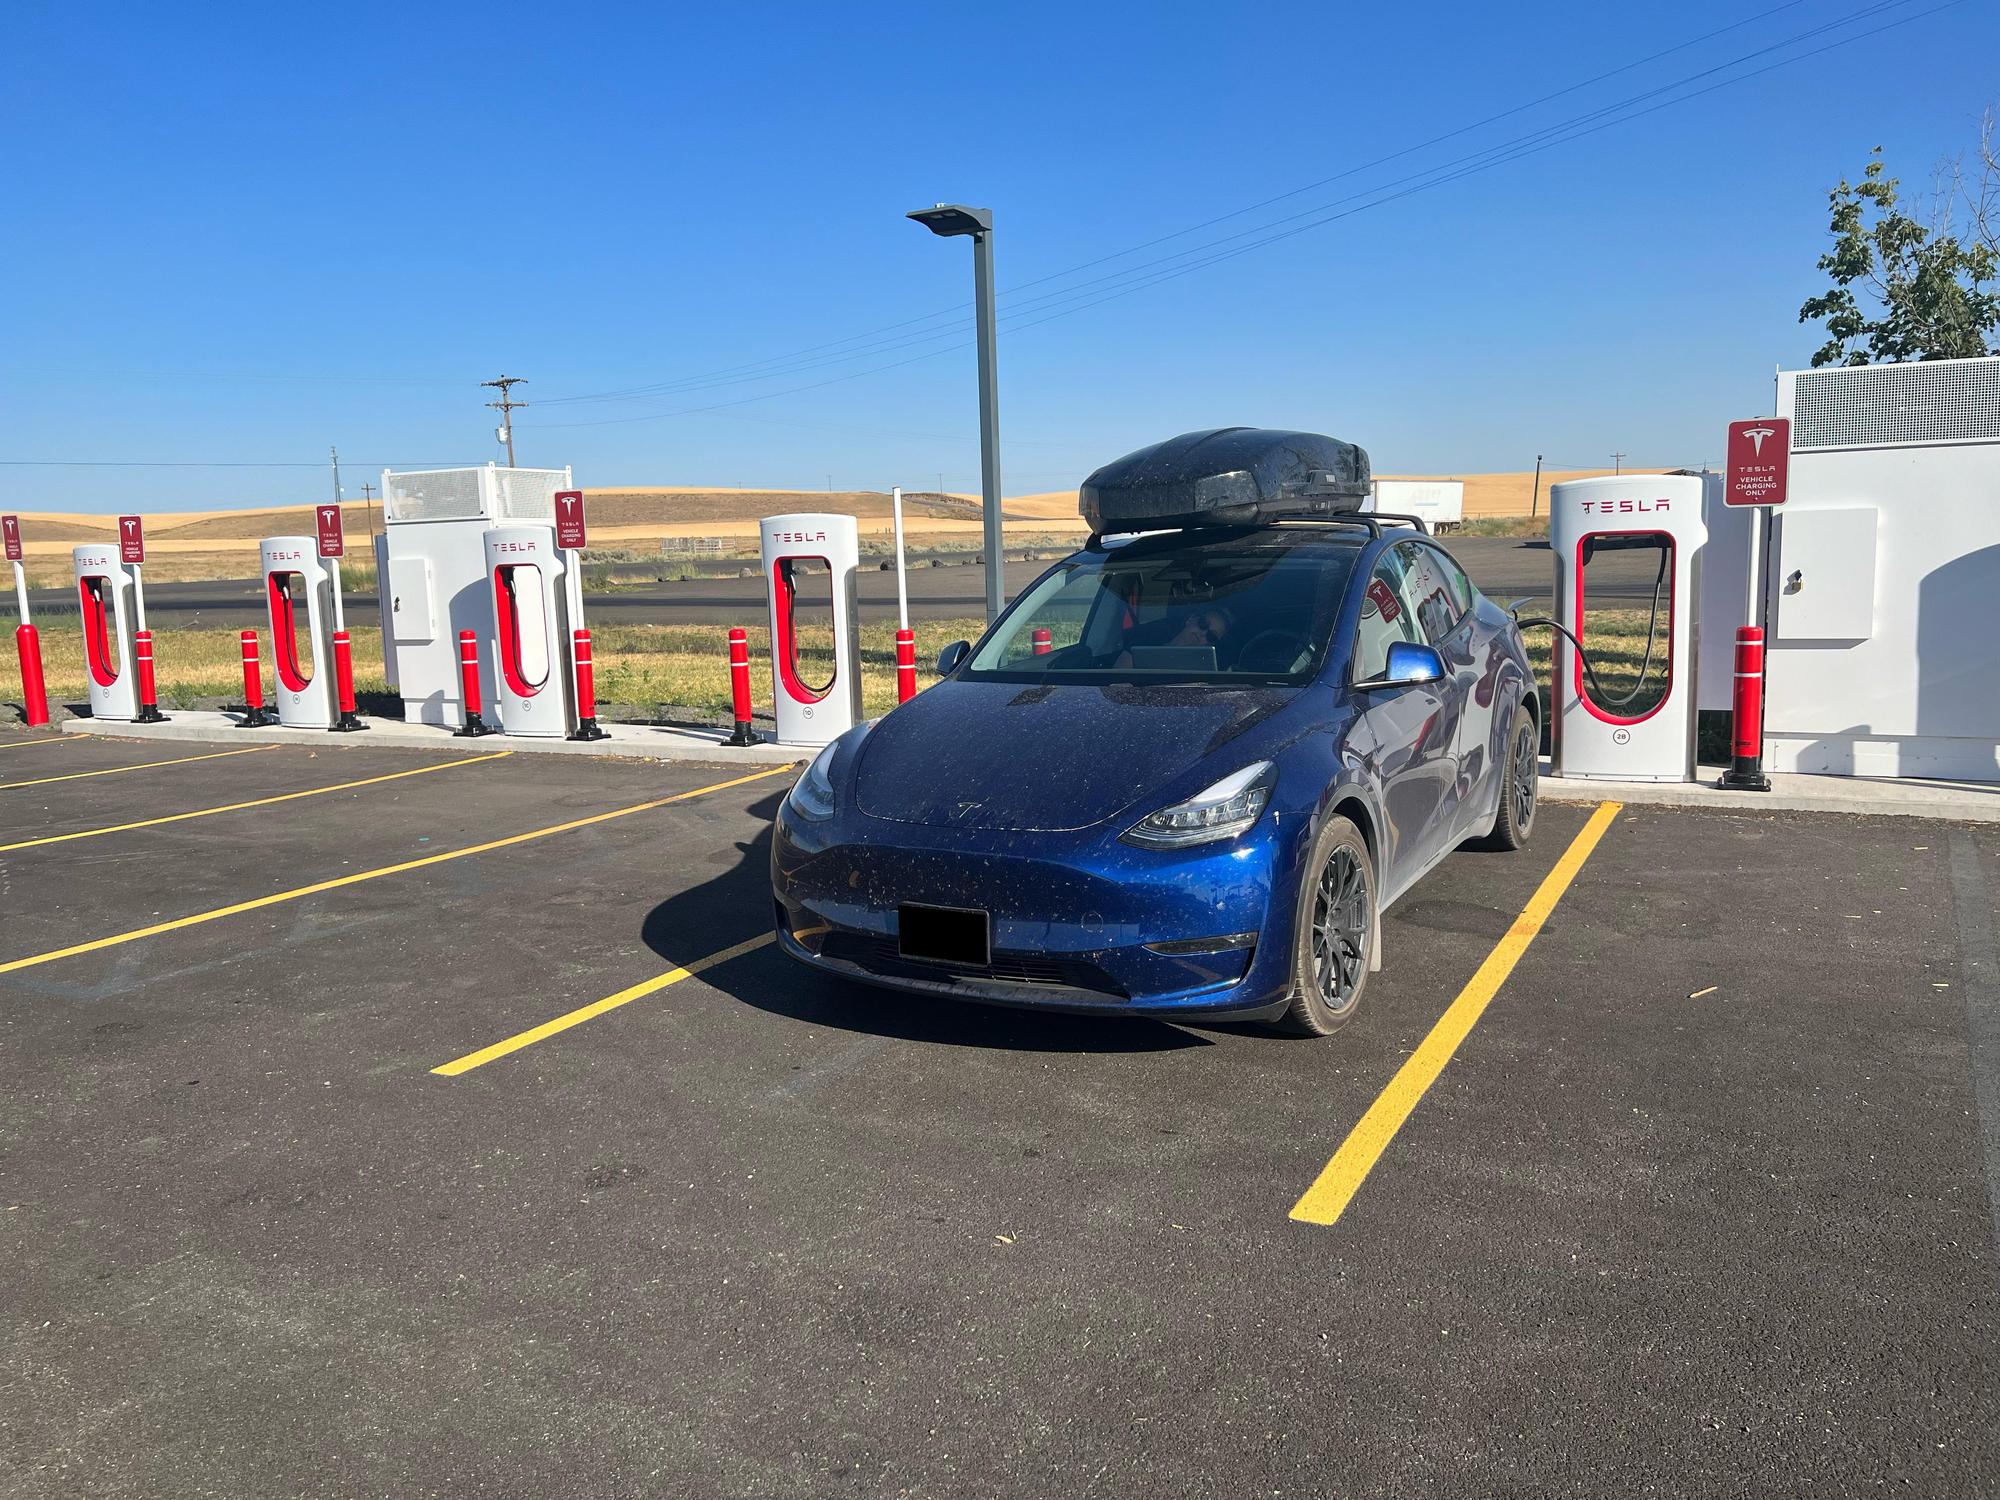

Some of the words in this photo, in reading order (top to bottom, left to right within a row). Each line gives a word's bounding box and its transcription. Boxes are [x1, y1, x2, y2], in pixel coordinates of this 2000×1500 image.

[1738, 465, 1776, 473] TESLA
[1740, 475, 1773, 483] VEHICLE
[1735, 482, 1777, 490] CHARGING
[1581, 499, 1670, 514] TESLA
[773, 532, 826, 543] TESLA
[493, 543, 536, 552] TESLA
[266, 552, 301, 560] TESLA
[78, 558, 107, 566] TESLA
